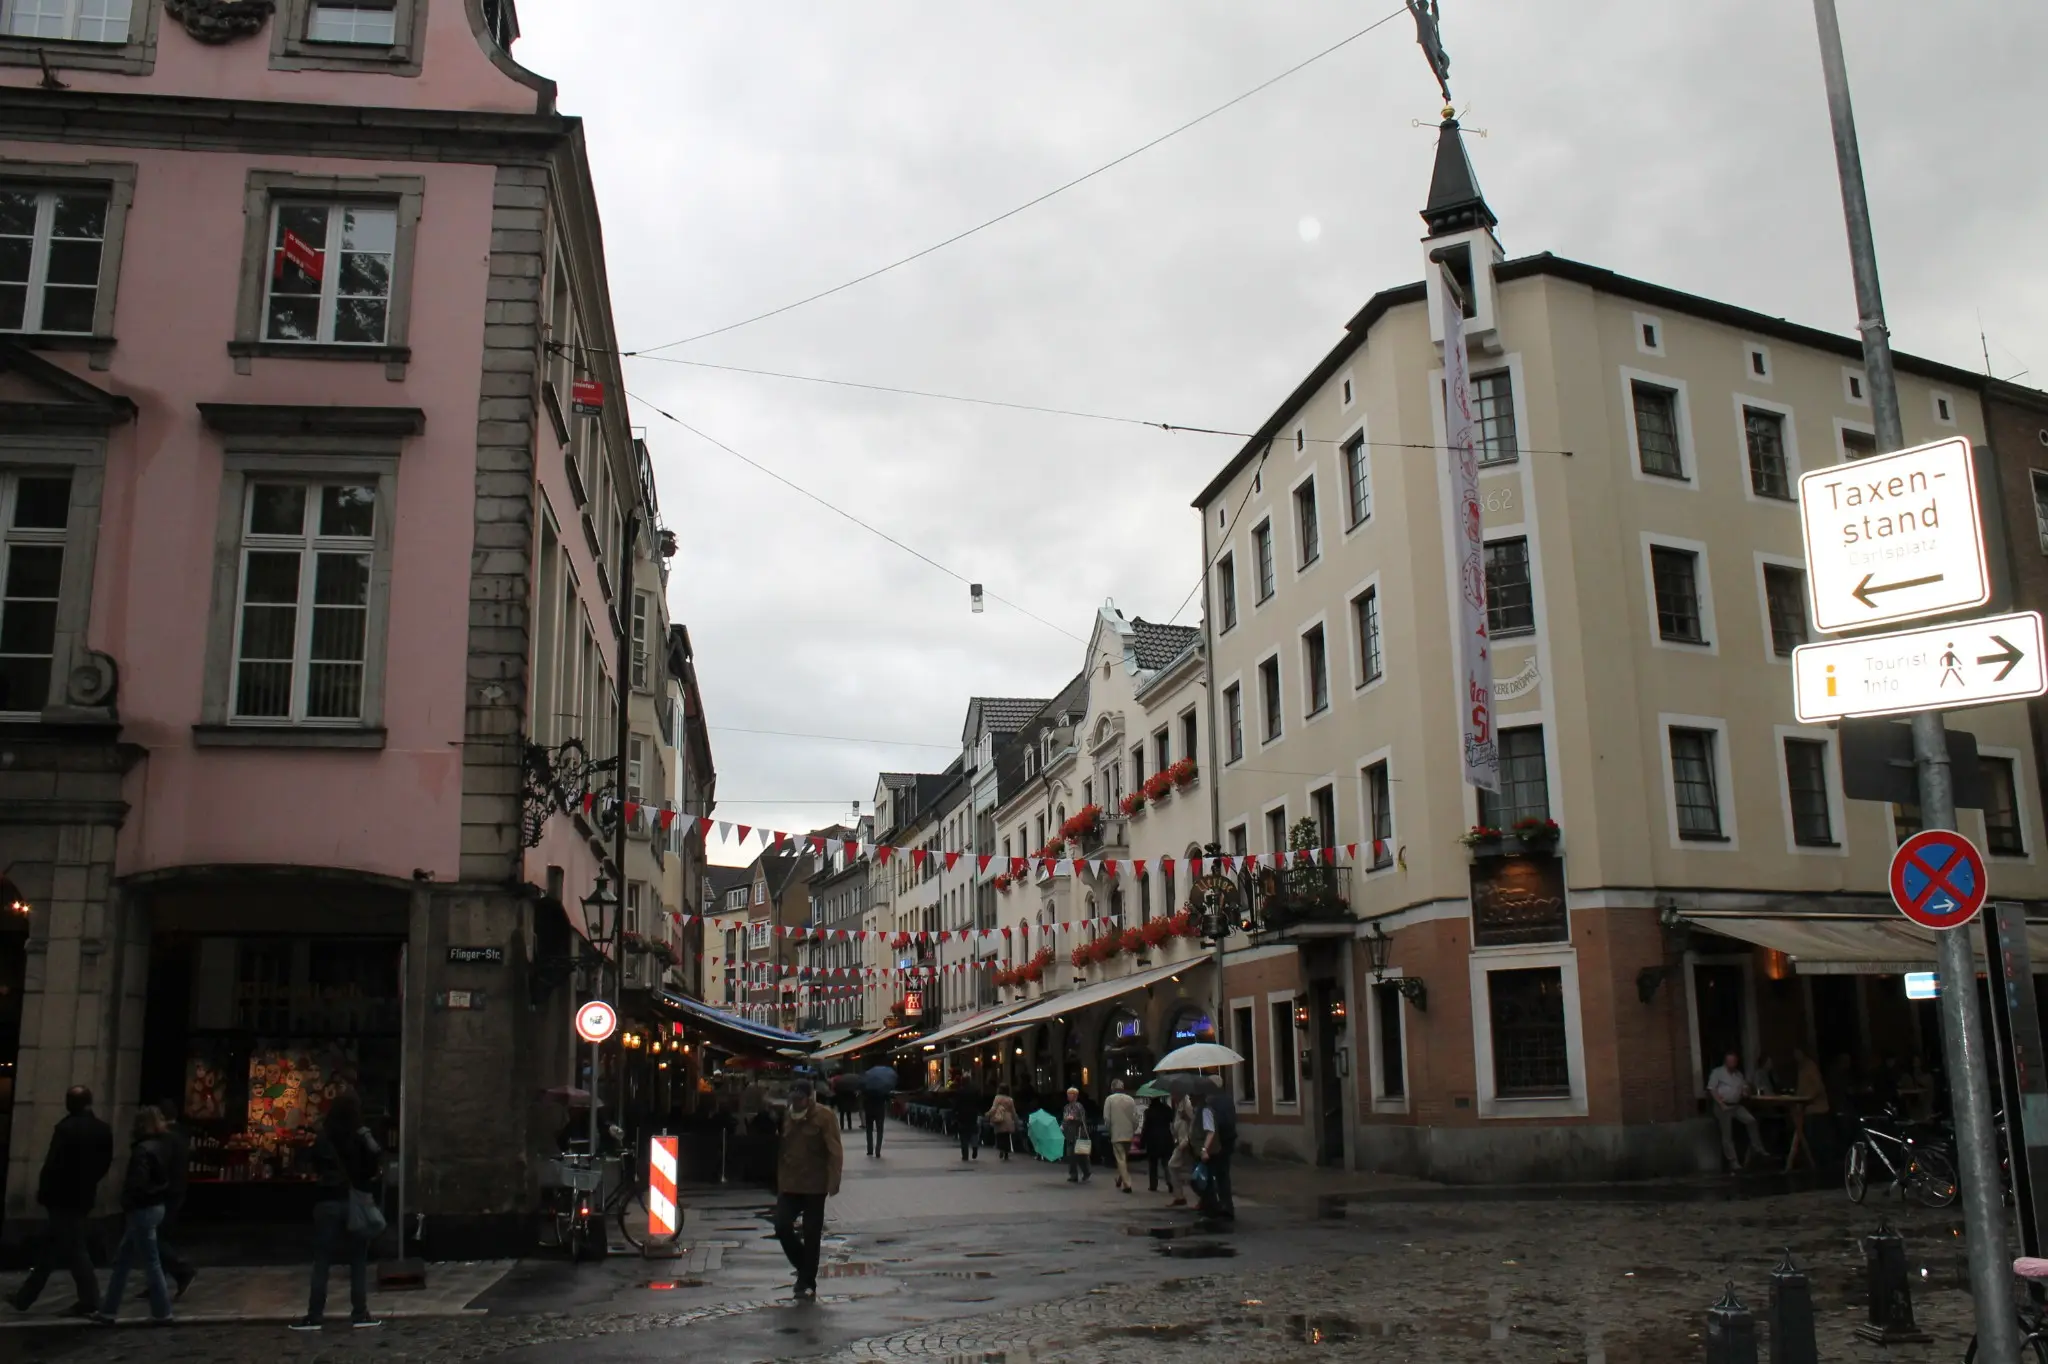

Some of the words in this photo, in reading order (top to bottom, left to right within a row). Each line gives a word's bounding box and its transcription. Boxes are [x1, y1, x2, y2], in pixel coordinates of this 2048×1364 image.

[1824, 471, 1946, 510] Taxen-
[1843, 498, 1939, 544] stand
[1865, 653, 1928, 671] Tourist
[1864, 676, 1899, 694] Info
[450, 948, 501, 961] Flinger-Str.
